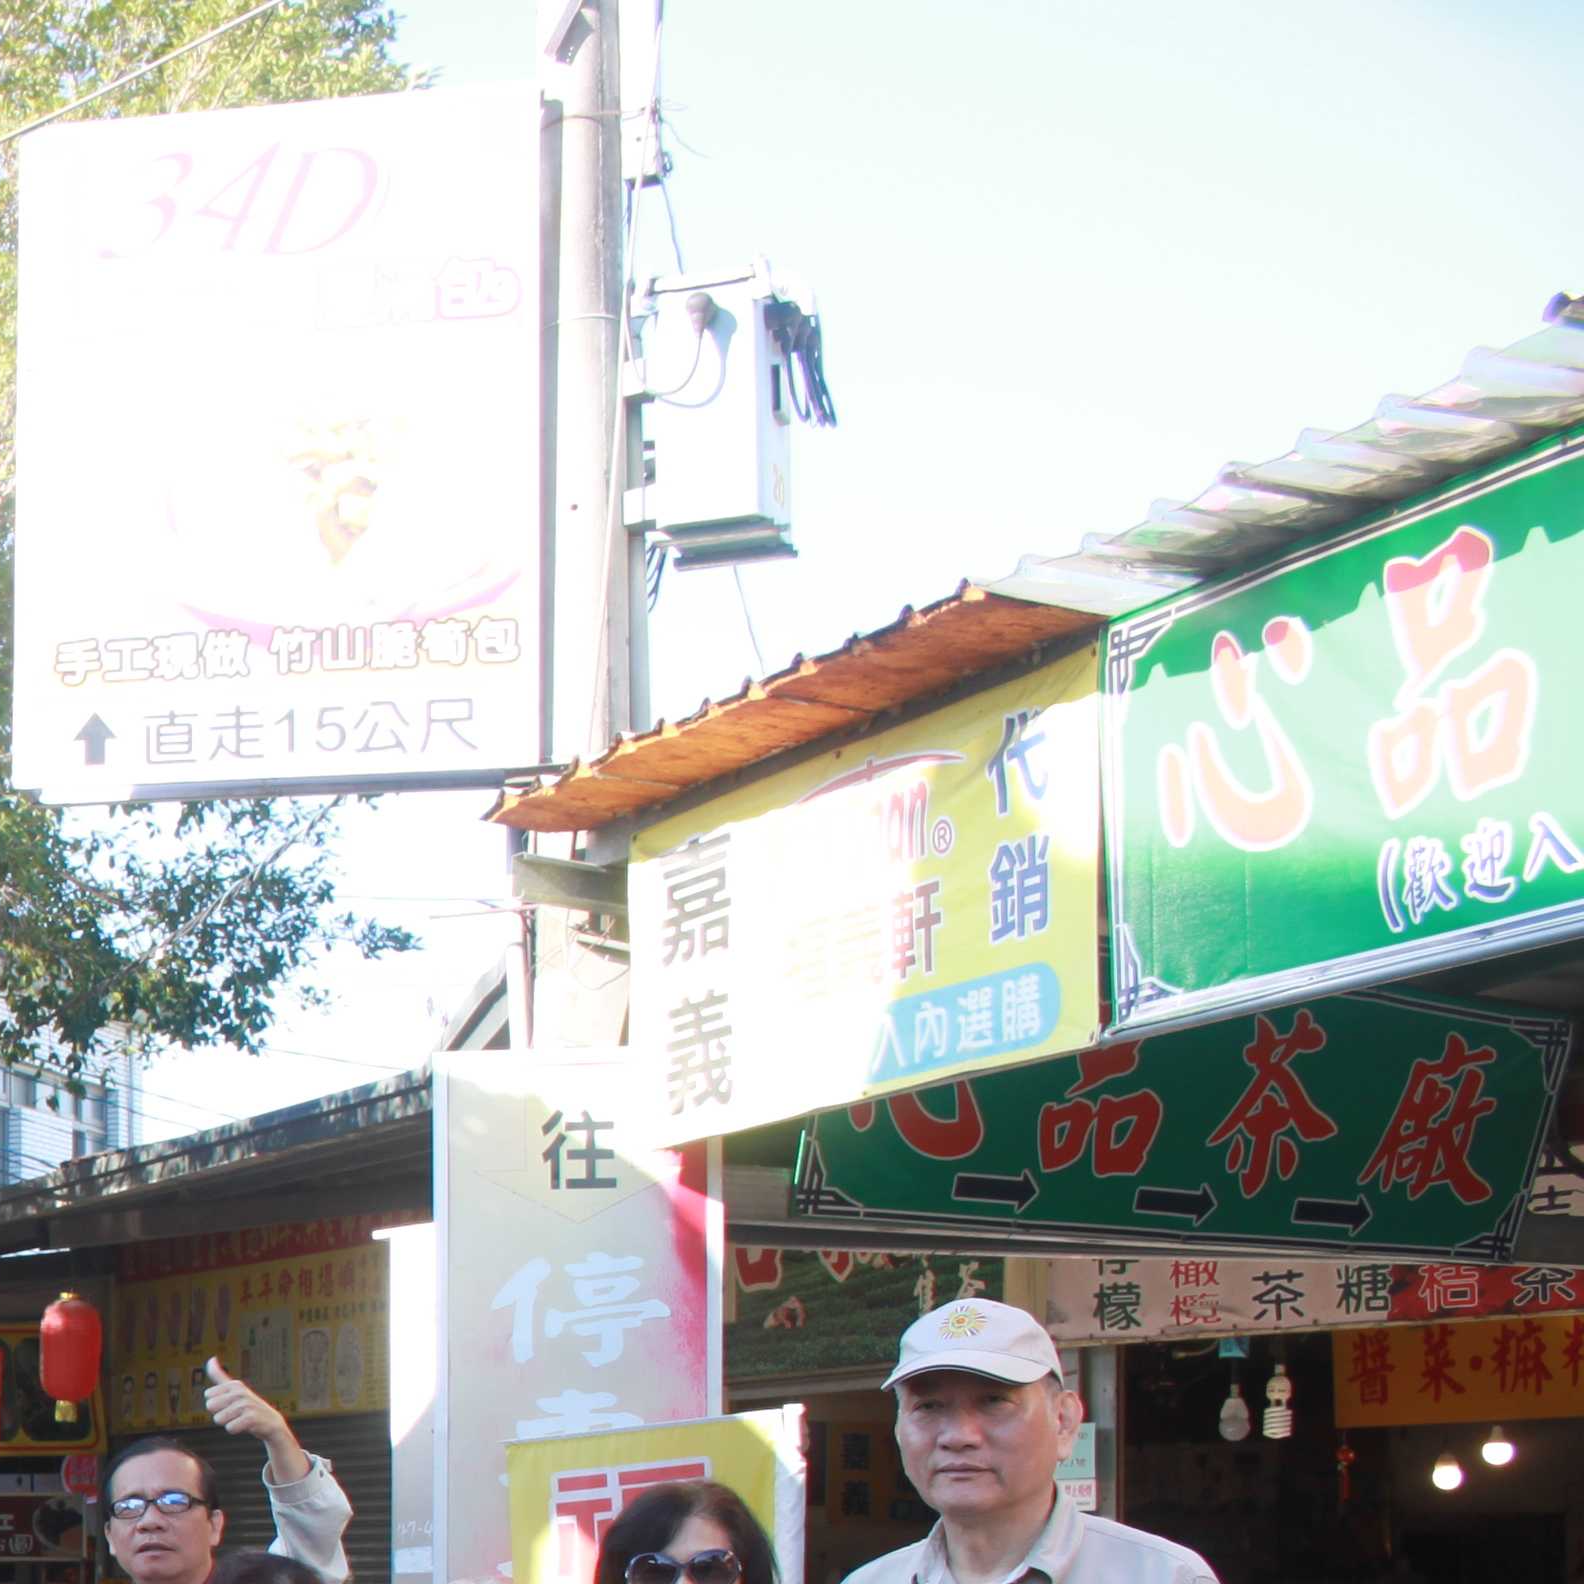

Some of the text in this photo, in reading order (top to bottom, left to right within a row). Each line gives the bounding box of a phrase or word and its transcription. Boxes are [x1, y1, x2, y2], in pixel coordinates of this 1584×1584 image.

[54, 630, 251, 686] 手工現做
[143, 698, 479, 765] 直走15公尺
[662, 832, 732, 1115] 嘉義
[542, 1110, 617, 1190] 往
